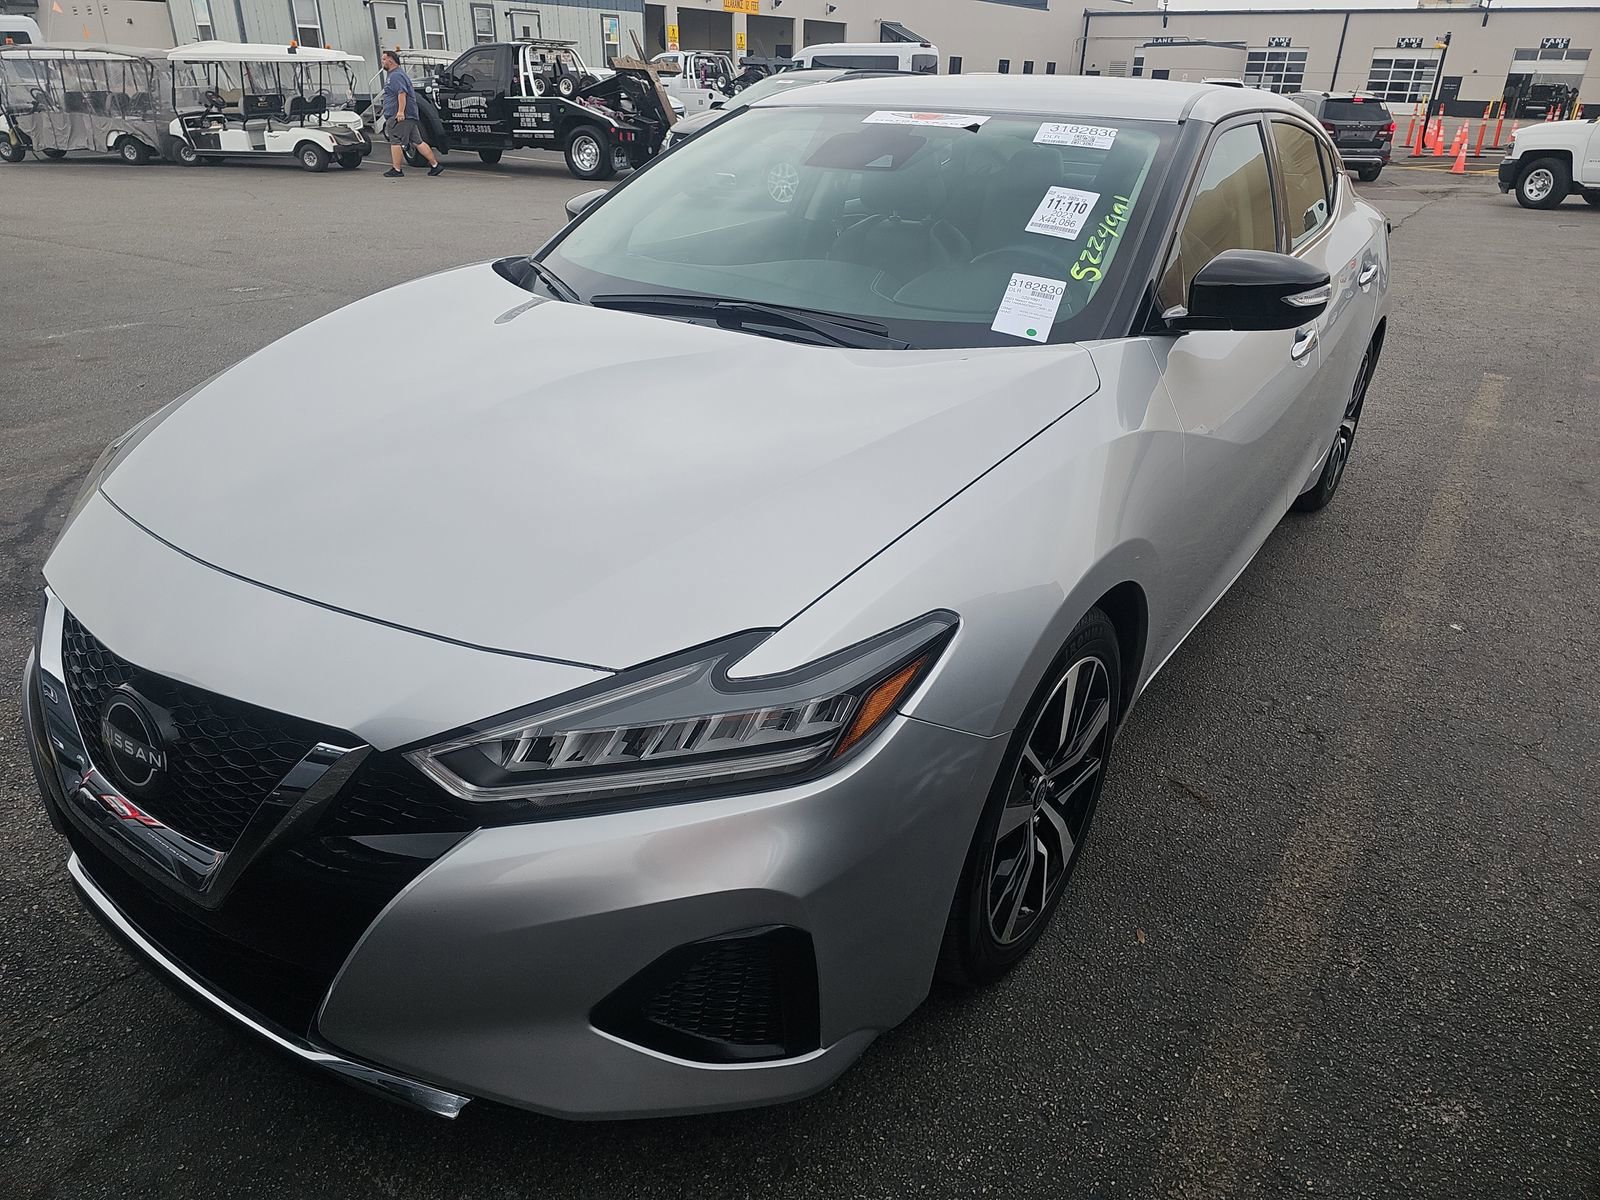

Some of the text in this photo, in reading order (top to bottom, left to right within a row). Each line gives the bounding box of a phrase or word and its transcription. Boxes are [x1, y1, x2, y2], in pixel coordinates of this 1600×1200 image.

[1047, 197, 1088, 215] 11:110
[1050, 209, 1074, 220] 2023
[1038, 214, 1077, 228] X44,086
[1009, 278, 1064, 296] 3182830
[102, 720, 162, 768] NISSAN
